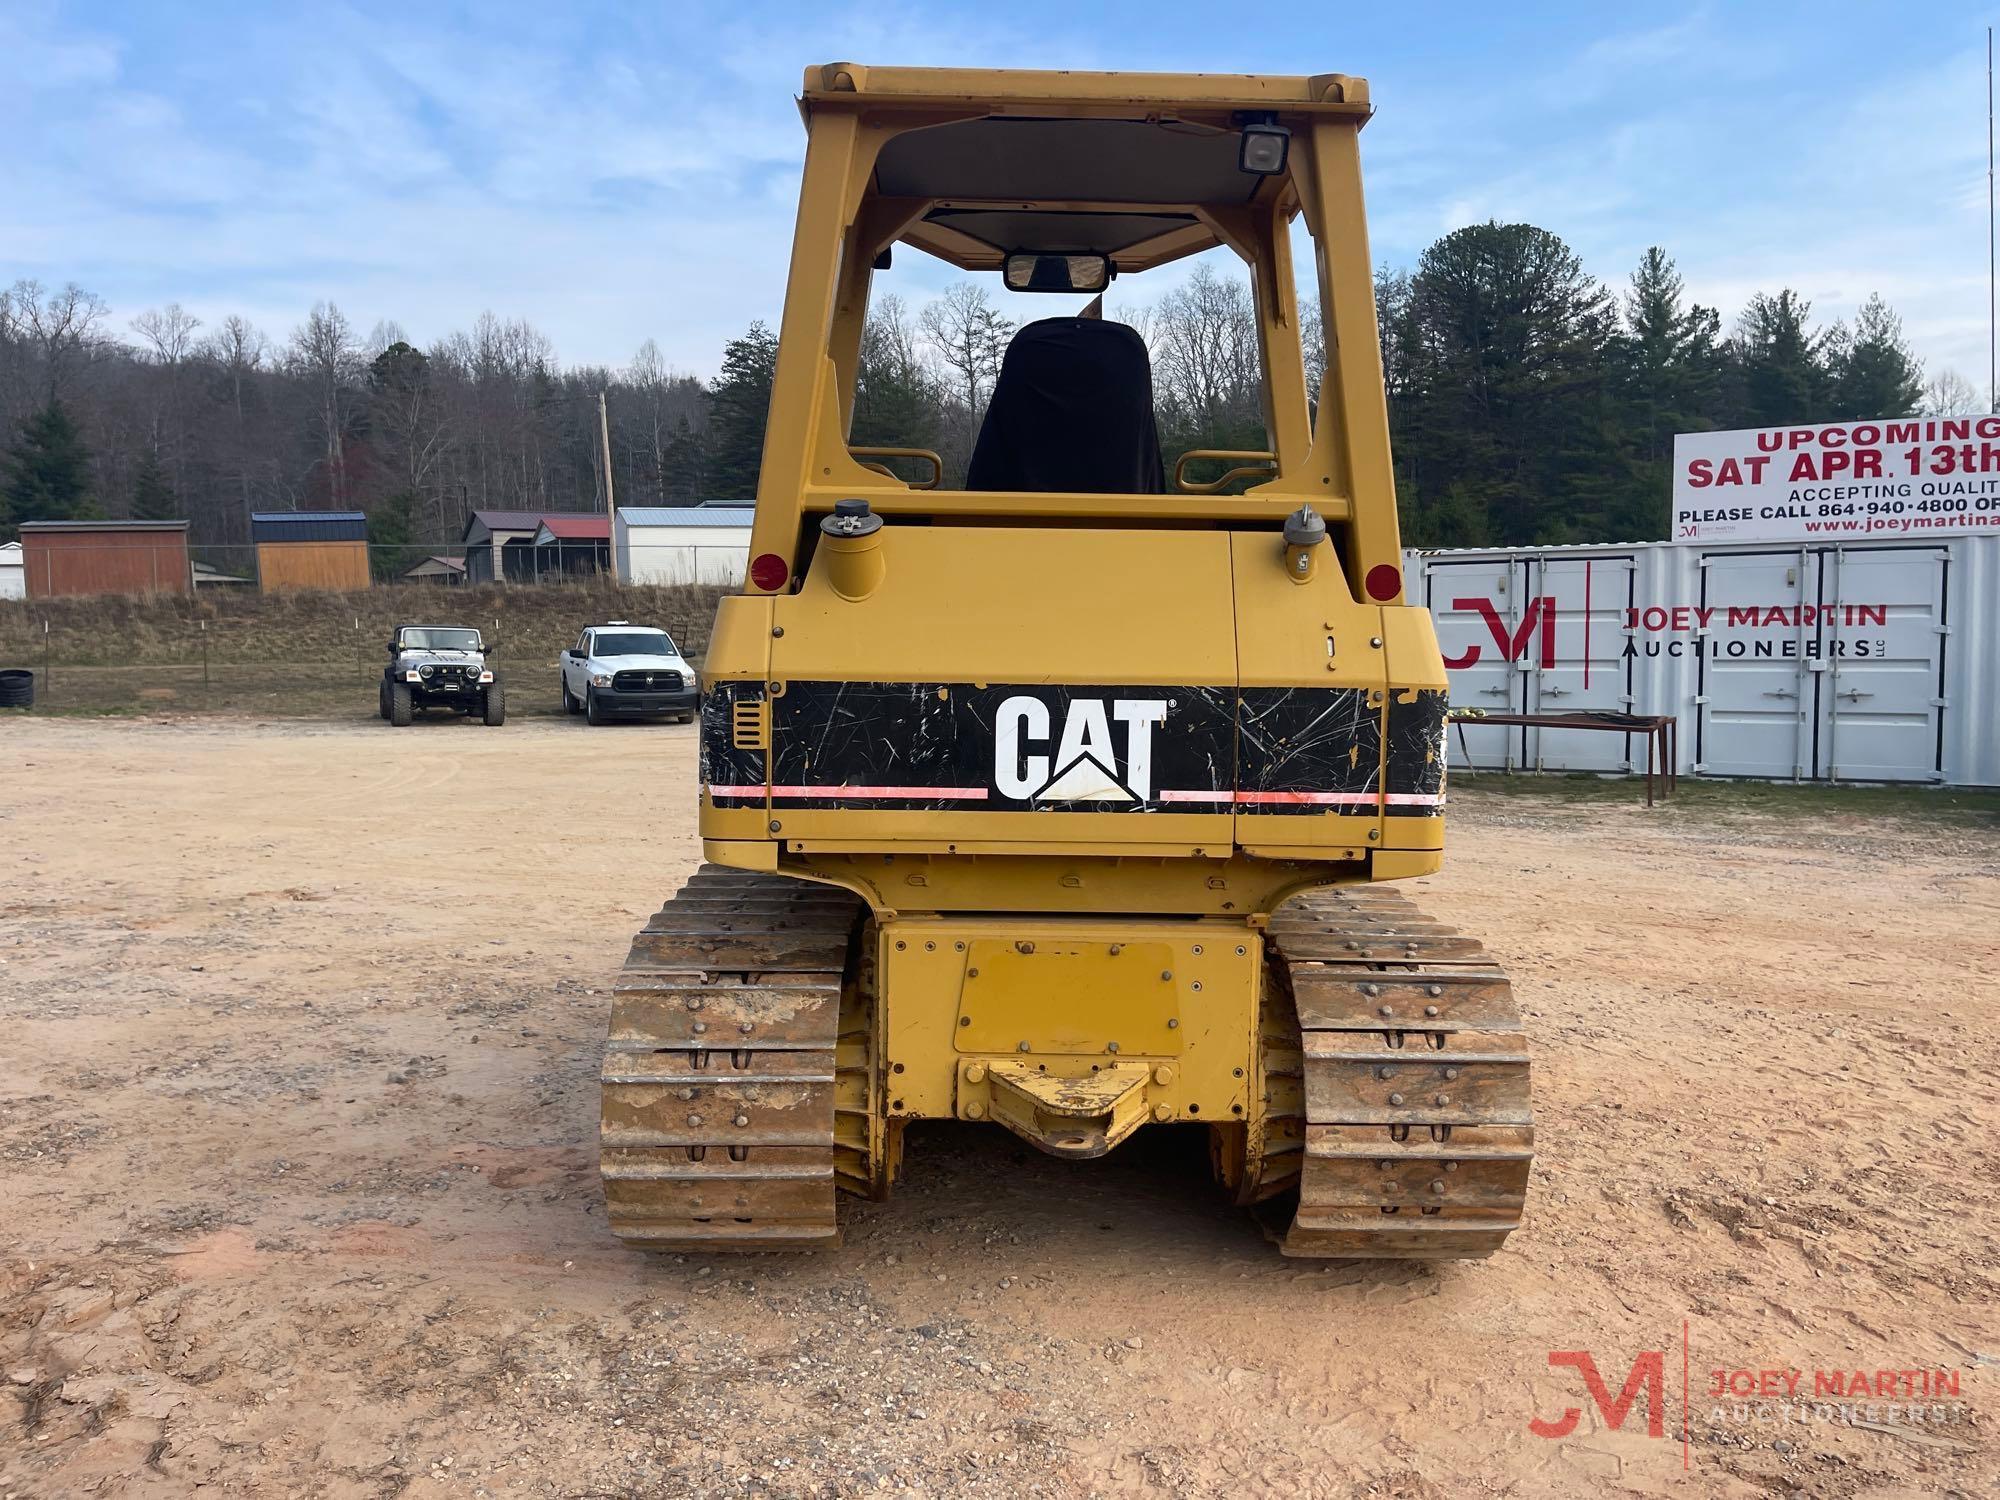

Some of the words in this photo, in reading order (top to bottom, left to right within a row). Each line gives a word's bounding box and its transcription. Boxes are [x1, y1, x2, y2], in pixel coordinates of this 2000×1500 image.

[1757, 418, 2000, 453] UPCOMING
[1687, 456, 1771, 488] SAT
[1788, 449, 1894, 482] APR.
[1904, 443, 2000, 476] 13th
[1788, 484, 1911, 502] ACCEPTING
[1679, 508, 1753, 523] PLEASE
[1760, 505, 1811, 519] CALL
[1622, 606, 1717, 632] JOEY
[1727, 604, 1888, 627] MARTIN
[1621, 639, 1870, 658] AUCTIONEERS
[1875, 639, 1886, 657] LLC
